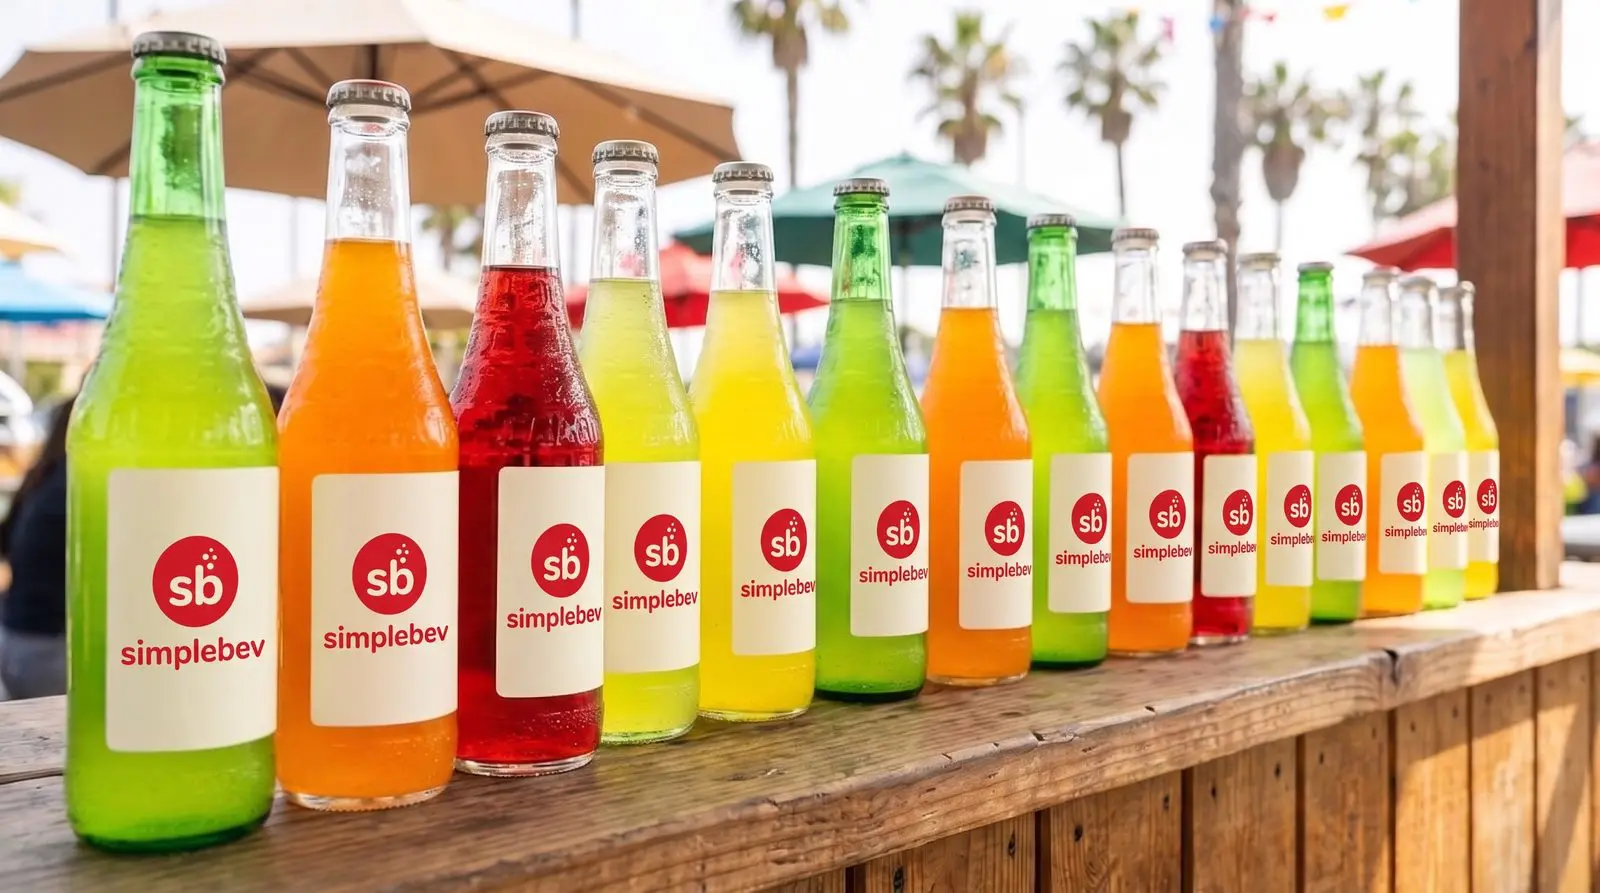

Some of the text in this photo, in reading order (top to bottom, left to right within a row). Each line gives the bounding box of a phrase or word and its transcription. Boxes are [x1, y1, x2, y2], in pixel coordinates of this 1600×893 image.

[1291, 498, 1309, 518] sb
[1342, 497, 1359, 516] sb
[1403, 495, 1421, 513] sb
[1448, 492, 1463, 509] sb
[1482, 490, 1495, 506] sb
[1080, 509, 1102, 532] sb
[1157, 506, 1180, 527] sb
[1230, 504, 1249, 525] sb
[886, 519, 913, 545] sb
[994, 518, 1019, 543] sb
[646, 536, 679, 566] sb
[771, 529, 800, 557] sb
[1133, 544, 1193, 561] simplebev
[544, 547, 580, 581] sb
[859, 564, 928, 586] simplebev
[967, 562, 1031, 581] simplebev
[169, 565, 223, 606] sb
[367, 559, 414, 596] sb
[740, 577, 815, 600] simplebev
[612, 589, 698, 613] simplebev
[507, 605, 602, 632] simplebev
[323, 622, 449, 653] simplebev
[121, 636, 265, 670] simplebev
